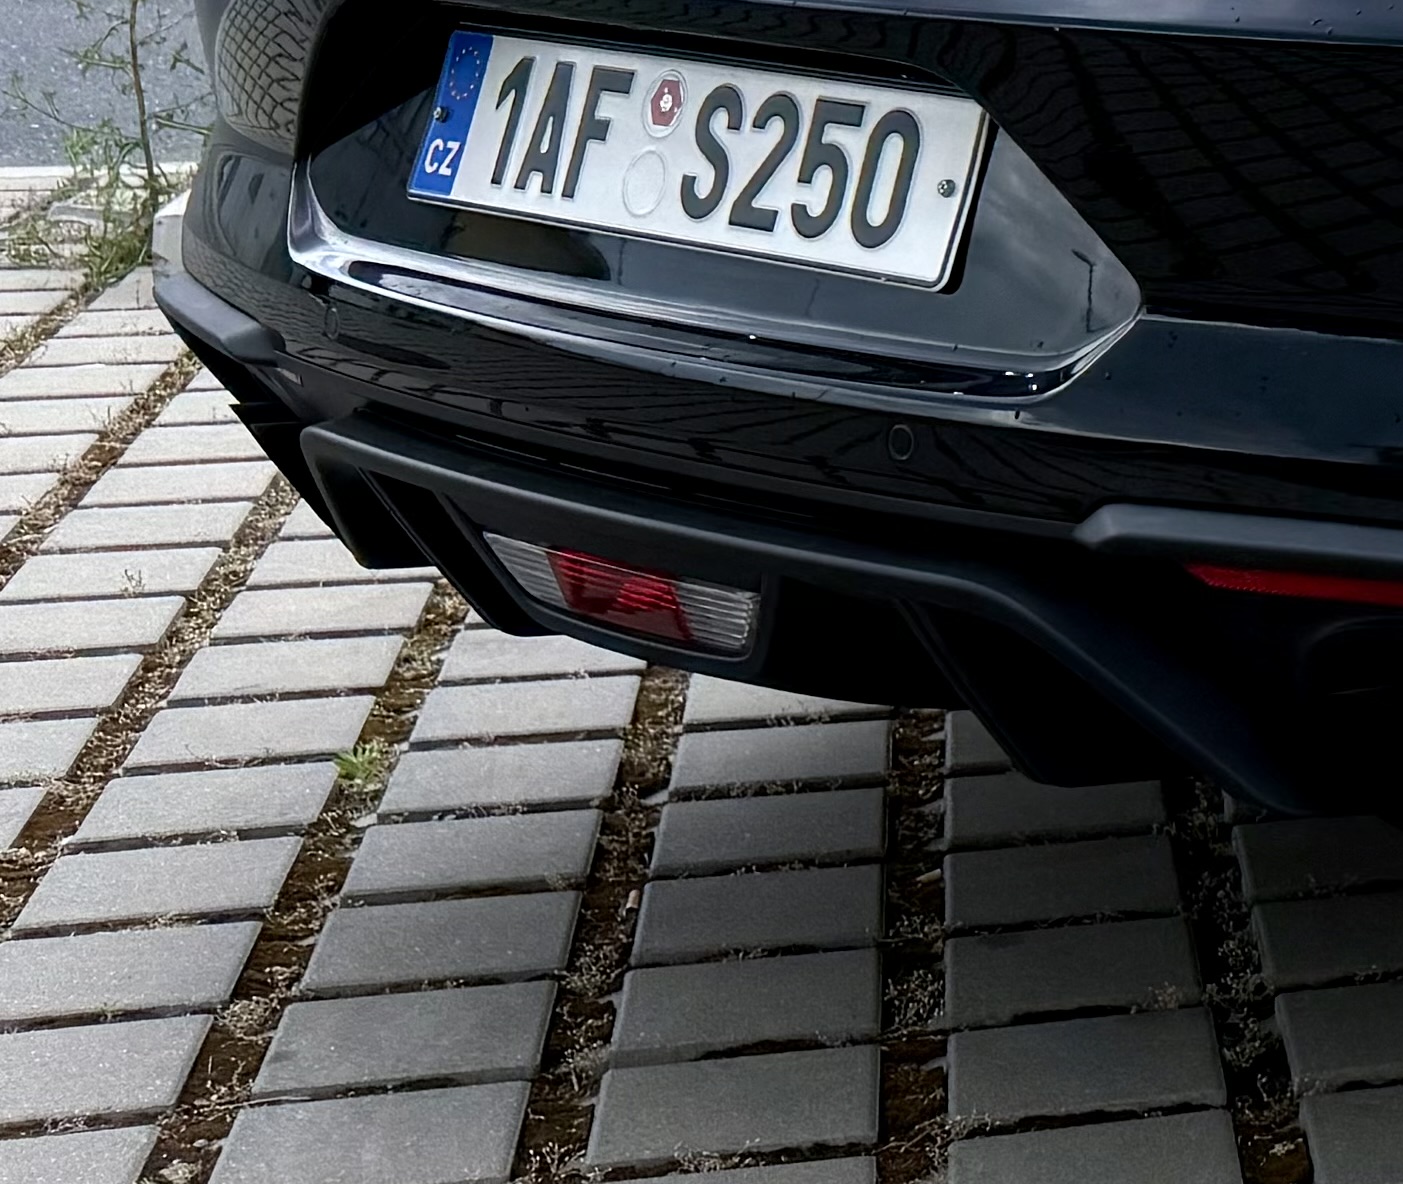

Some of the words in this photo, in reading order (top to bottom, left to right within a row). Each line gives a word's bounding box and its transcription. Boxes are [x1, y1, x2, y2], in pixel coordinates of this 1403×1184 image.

[424, 138, 461, 176] CZ
[490, 55, 638, 199] 1AF
[680, 82, 923, 250] S250
